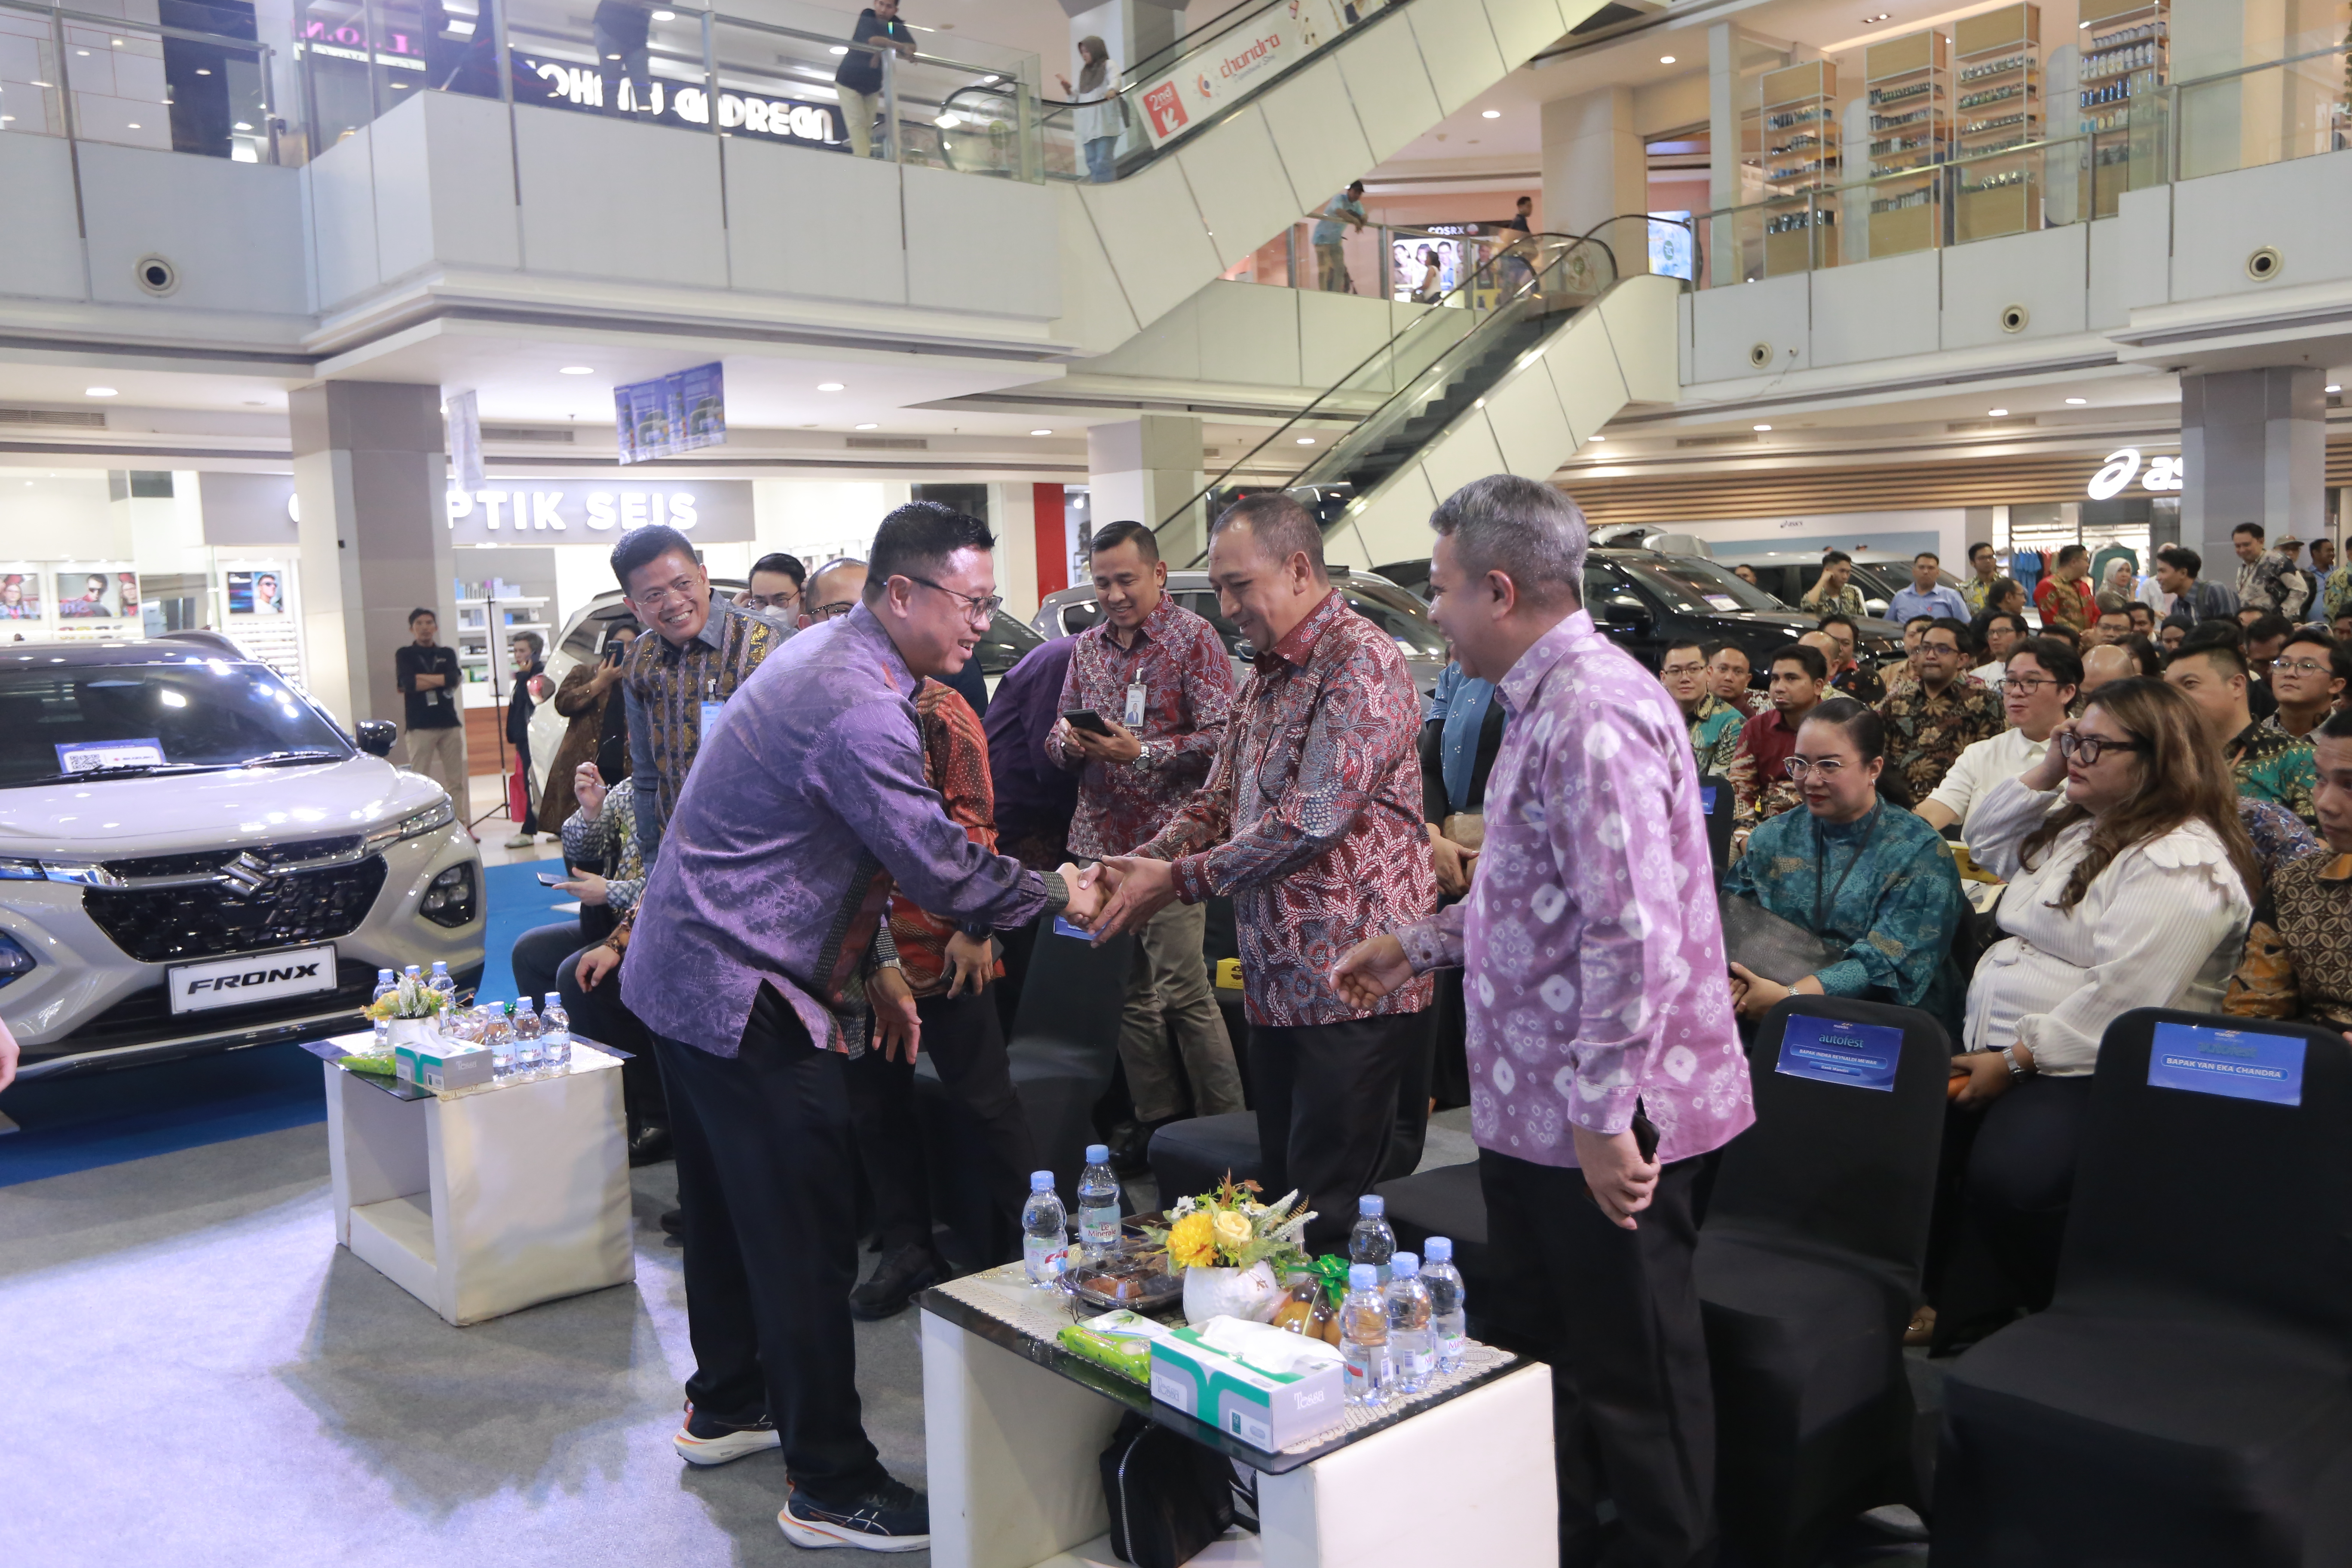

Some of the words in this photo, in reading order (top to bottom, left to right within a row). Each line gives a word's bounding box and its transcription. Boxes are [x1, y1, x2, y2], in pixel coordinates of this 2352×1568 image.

[1220, 34, 1281, 78] chandra
[1149, 86, 1172, 111] 2nd
[1427, 226, 1464, 236] COSRX
[446, 490, 567, 530] PTIK
[586, 492, 698, 530] SEIS
[188, 962, 320, 995] FRONX
[1819, 1034, 1864, 1048] autofest
[2166, 1057, 2196, 1067] BAPAK
[2236, 1067, 2281, 1078] CHANDRA
[1088, 1228, 1116, 1237] Minerale
[1156, 1375, 1179, 1402] Tessa
[1294, 1390, 1324, 1410] Tessa
